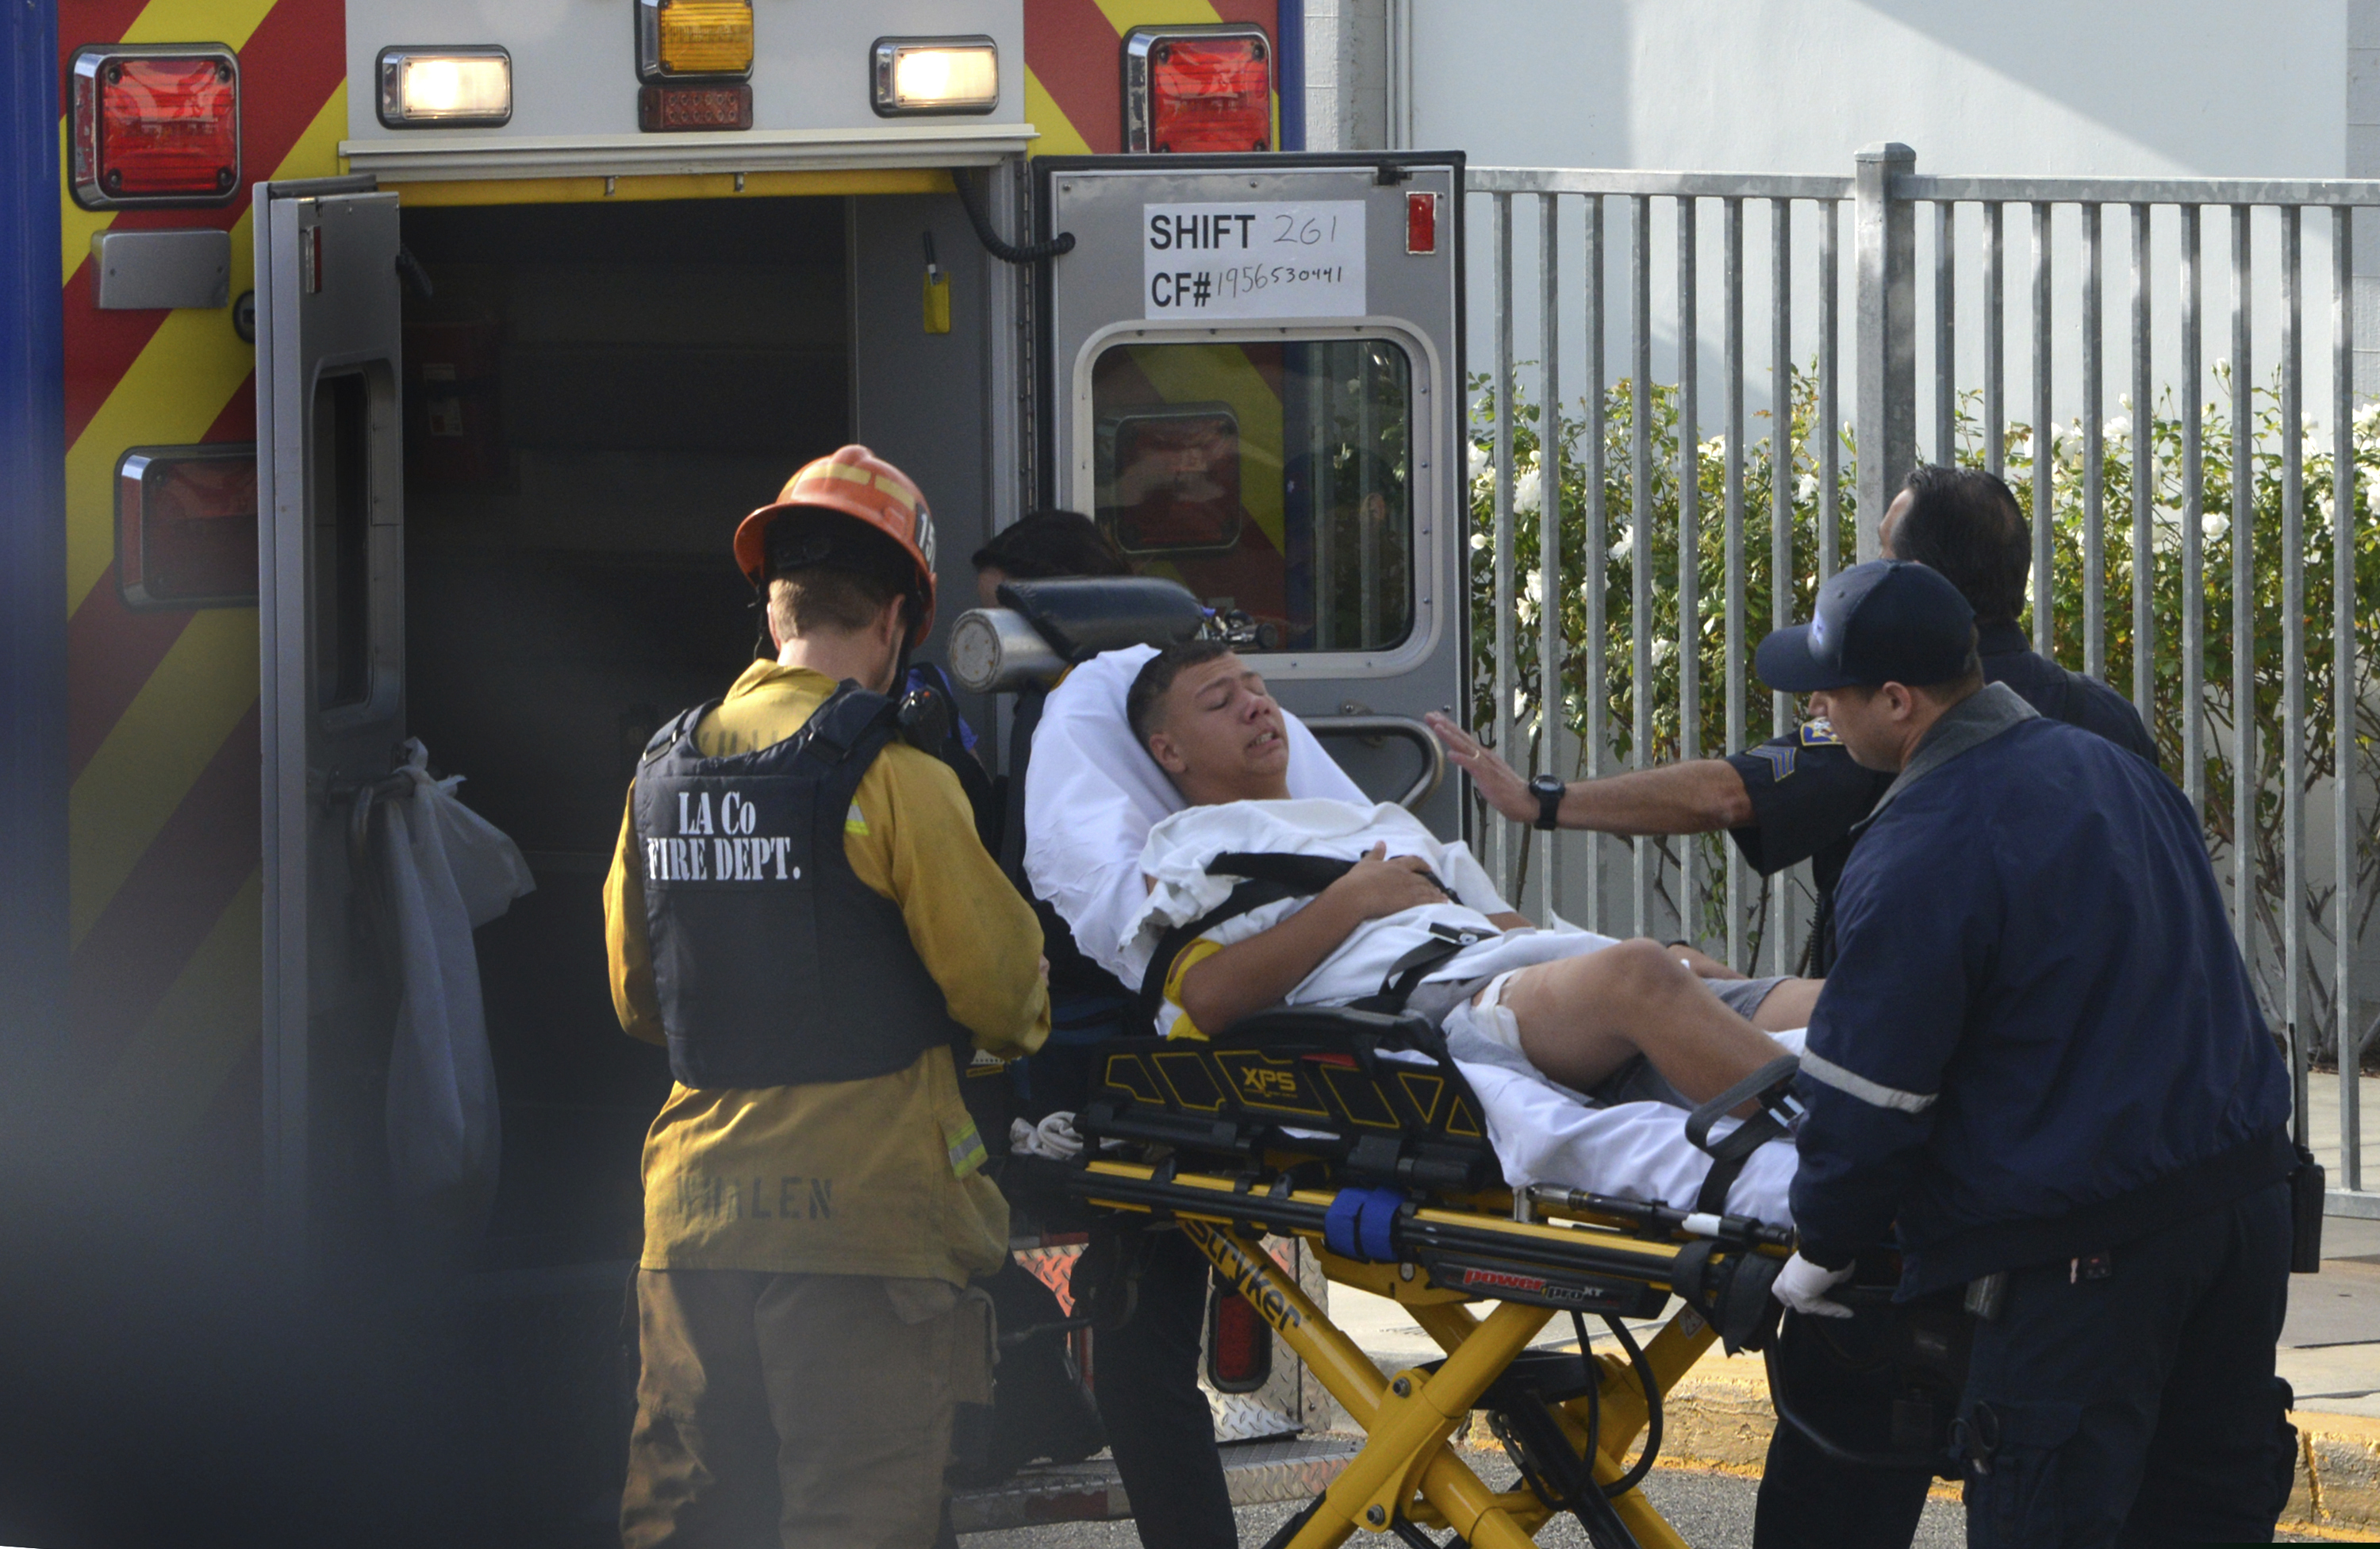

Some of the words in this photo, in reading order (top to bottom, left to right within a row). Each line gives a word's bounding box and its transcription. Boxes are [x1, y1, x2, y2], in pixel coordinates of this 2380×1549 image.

[1150, 214, 1256, 249] SHIFT
[1273, 214, 1337, 244] 261
[1151, 271, 1211, 308] CF#
[678, 791, 714, 835] LA
[721, 791, 757, 835] Co
[647, 837, 708, 880] FIRE
[714, 837, 801, 880] DEPT.
[1241, 1067, 1296, 1092] XPS
